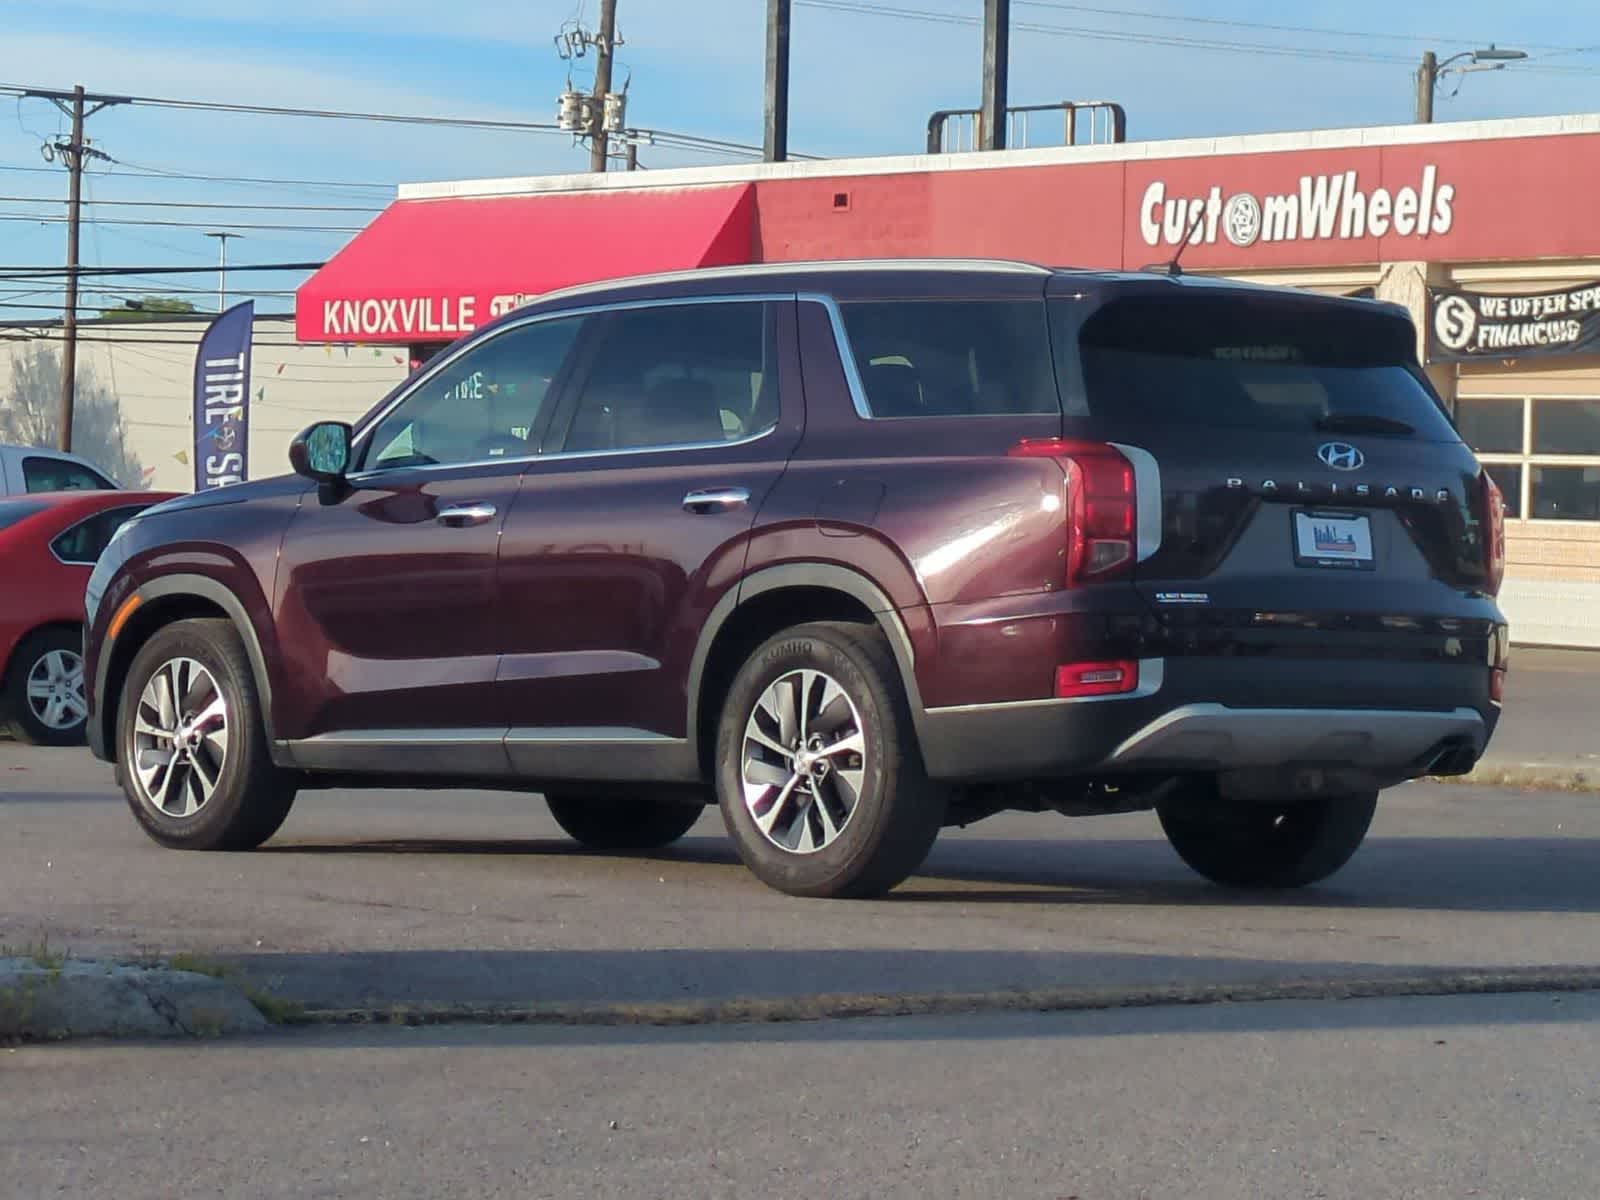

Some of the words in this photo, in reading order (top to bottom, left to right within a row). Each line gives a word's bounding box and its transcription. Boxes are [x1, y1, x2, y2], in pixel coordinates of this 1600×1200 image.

[323, 295, 476, 334] KNOXVILLE
[1479, 296, 1509, 317] WE
[1510, 293, 1567, 316] OFFER
[1477, 319, 1581, 348] FINANCING
[205, 352, 244, 425] TIRE
[1227, 477, 1449, 502] PALISADE
